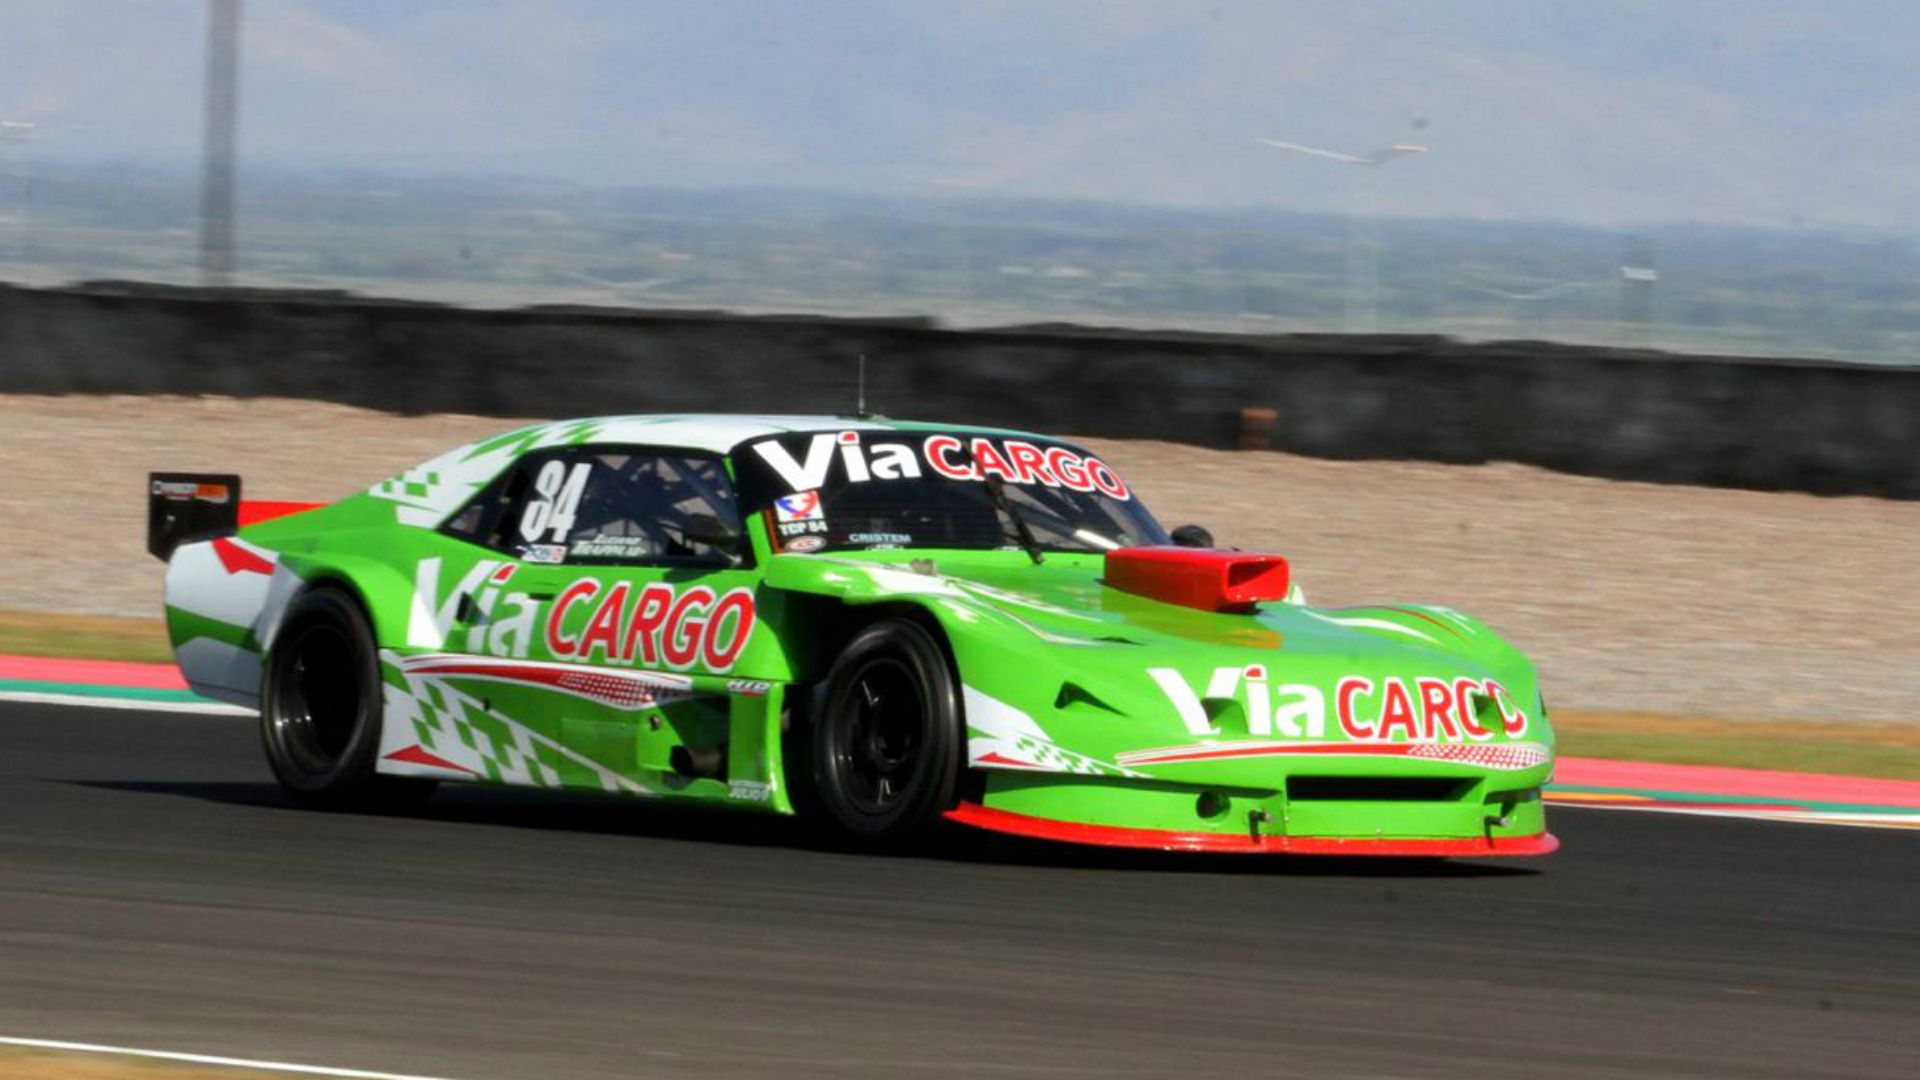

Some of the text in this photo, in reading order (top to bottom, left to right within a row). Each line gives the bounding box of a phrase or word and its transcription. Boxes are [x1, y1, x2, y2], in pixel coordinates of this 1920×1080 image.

[519, 460, 593, 543] 84
[752, 432, 1131, 501] Via CARGO
[406, 557, 756, 672] Via CARGO
[1146, 664, 1325, 741] Via
